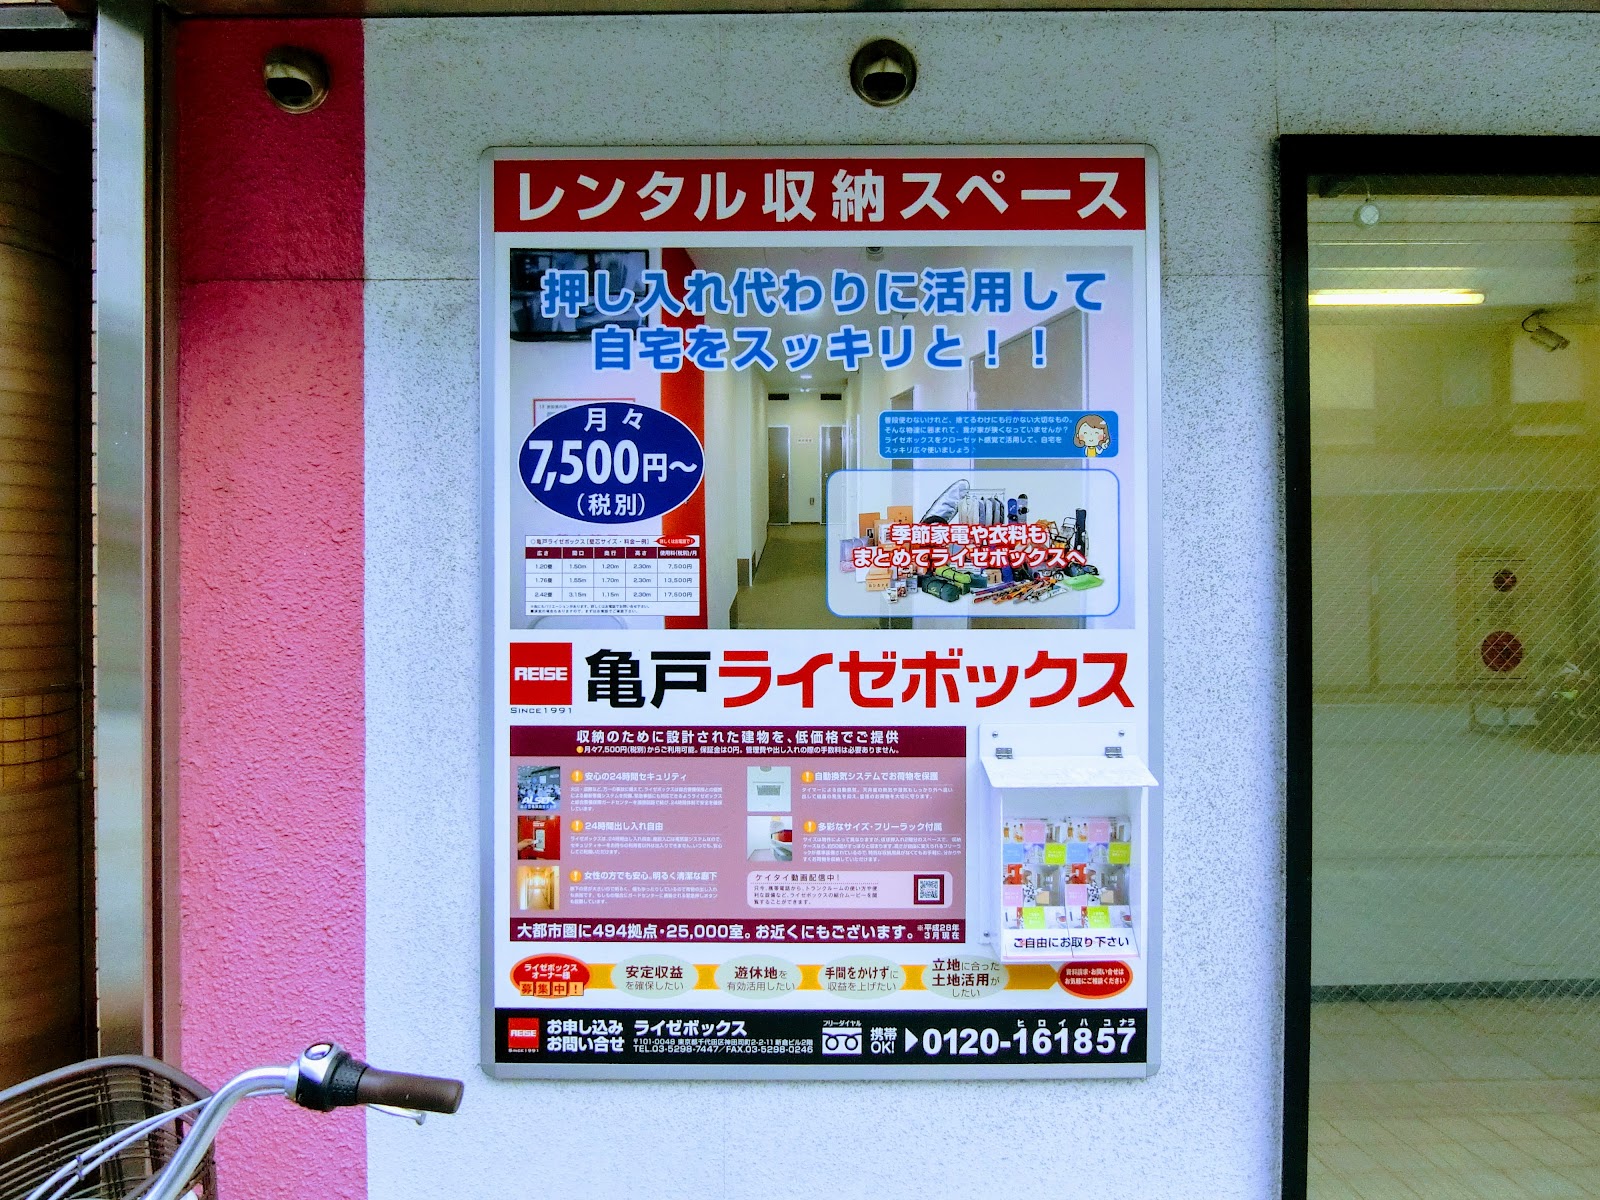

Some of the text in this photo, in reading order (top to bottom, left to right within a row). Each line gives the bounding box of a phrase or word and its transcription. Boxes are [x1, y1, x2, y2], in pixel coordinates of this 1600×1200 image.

[518, 169, 1127, 223] レンタル収納スペース
[541, 268, 1107, 317] 押し入れ代わりに活用して
[591, 325, 1049, 372] 自宅をスッキリと！！
[584, 407, 644, 432] 月々
[889, 523, 1049, 545] 季節家電や衣料も
[852, 547, 1087, 568] まとめてライゼボックスへ
[514, 666, 568, 681] REISE
[585, 648, 1135, 709] 亀戸ライゼボックス
[576, 730, 899, 744] 収納のために設計された建物を、低価格でご提供
[585, 772, 687, 782] 安心の24時間セキュリティ
[815, 771, 939, 781] 自動換気システムでお荷物を保護
[585, 821, 664, 831] 24時間出し入れ自由
[1013, 936, 1129, 949] ご自由にお取り下さい
[524, 963, 578, 972] ライゼボックス
[932, 958, 1000, 971] 立地に合った
[625, 966, 683, 979] 安定収益
[734, 966, 787, 980] 遊休地を
[825, 966, 898, 980] 手間をかけずに
[625, 981, 684, 991] を確保したい
[726, 981, 795, 991] 有効活用したい
[827, 981, 897, 991] 収益を上げたい
[932, 973, 1000, 987] 土地活用が
[952, 988, 980, 998] したい
[547, 1019, 624, 1035] お申し込み
[634, 1020, 748, 1037] ライゼボックス
[870, 1027, 898, 1041] 携帯
[547, 1036, 625, 1052] お問い合せ
[871, 1041, 895, 1054] OK!
[922, 1027, 1137, 1055] 0120-161857
